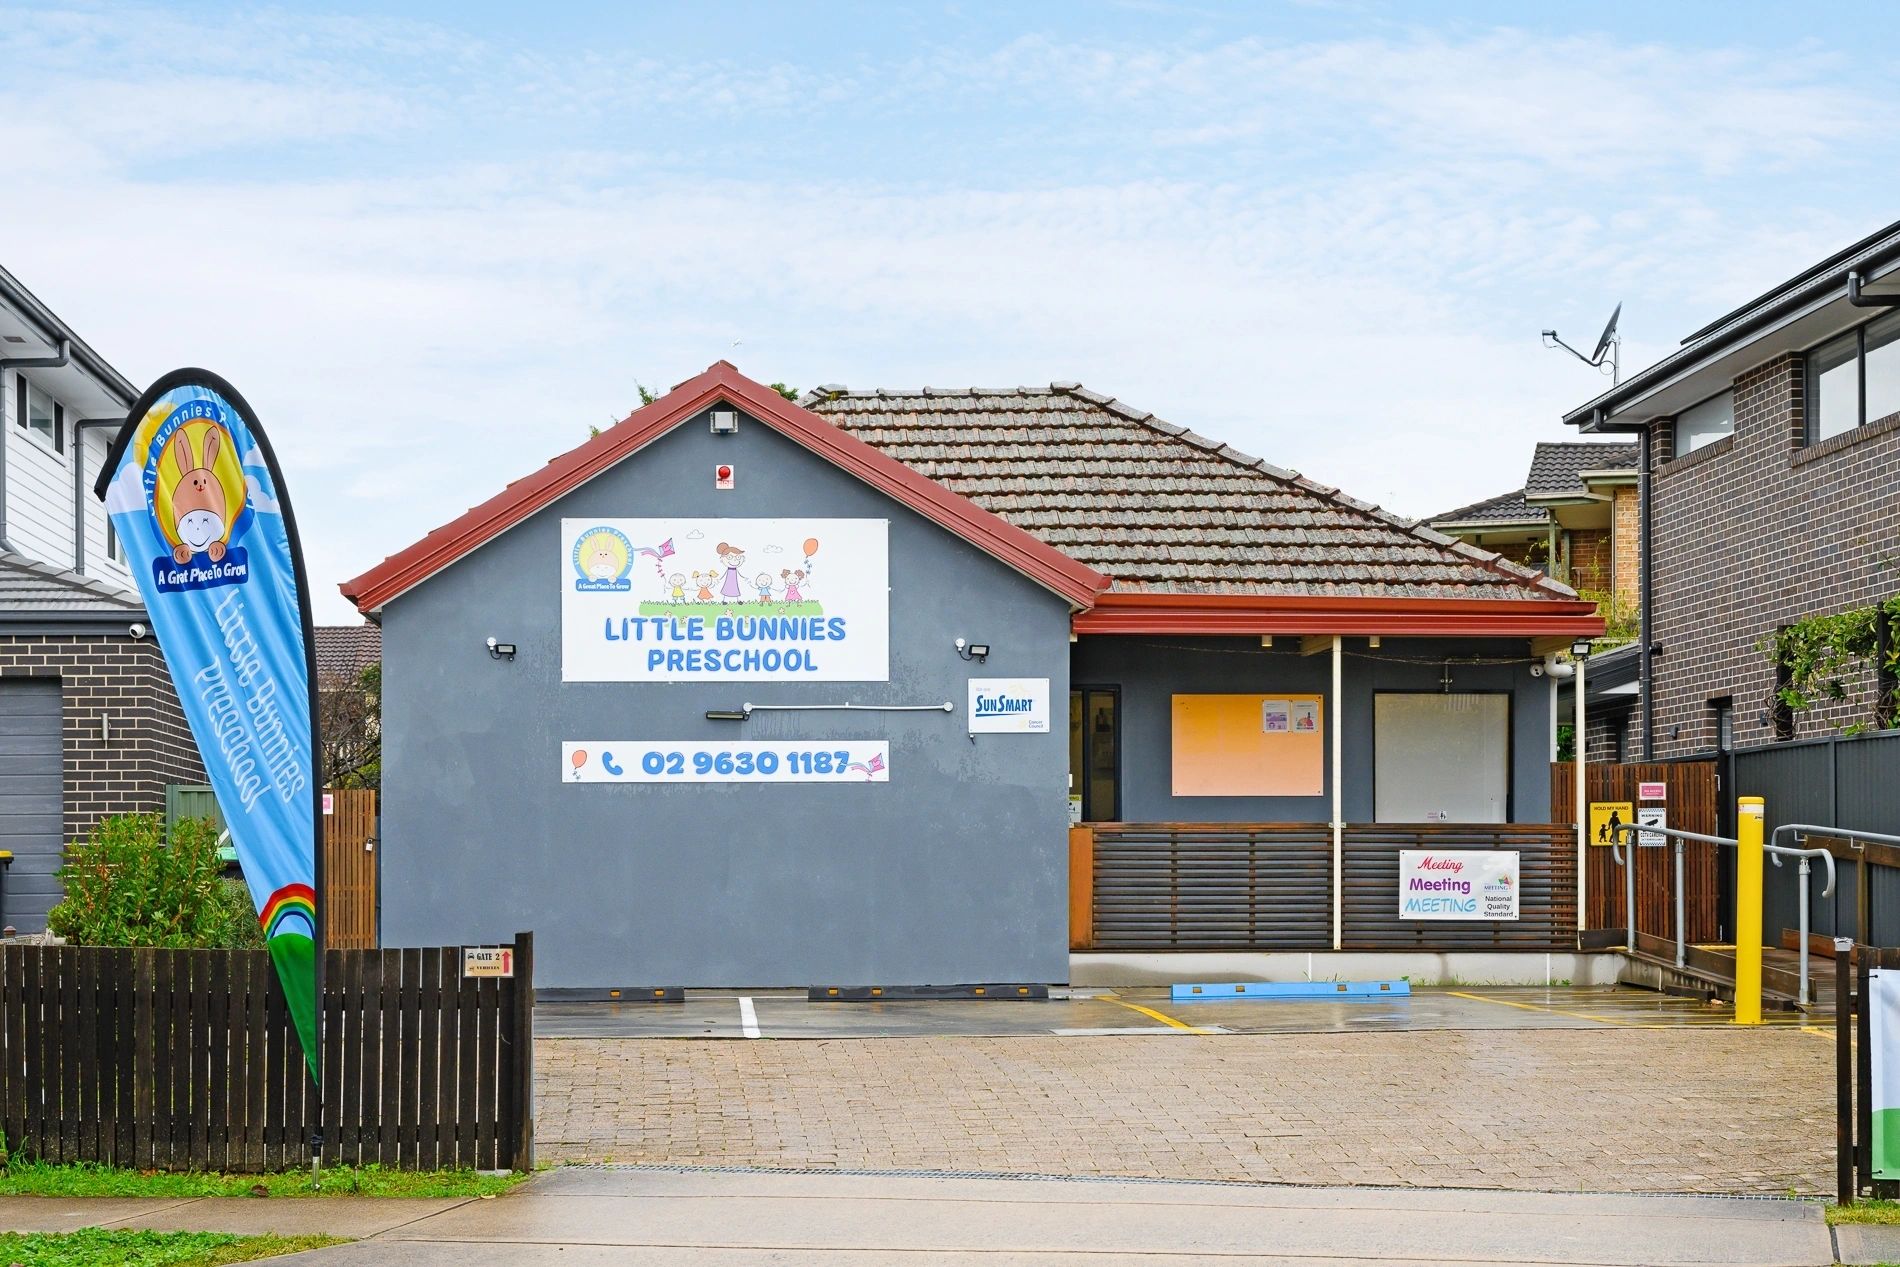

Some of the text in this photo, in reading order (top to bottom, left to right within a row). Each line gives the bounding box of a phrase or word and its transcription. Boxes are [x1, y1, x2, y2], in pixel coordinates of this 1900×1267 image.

[156, 404, 212, 448] Bunnies
[158, 570, 166, 585] A
[168, 570, 188, 585] Grat
[212, 564, 222, 579] To
[605, 617, 846, 641] LITTLE BUNNIES
[647, 648, 818, 672] PRESCHOOL
[215, 587, 305, 804] Little Bunnies
[193, 654, 271, 816] Preschool
[641, 751, 850, 775] 02 9630 1187
[1417, 855, 1464, 873] Meeting
[1409, 877, 1471, 895] Meeting
[1404, 897, 1477, 913] MEETING
[1487, 903, 1511, 911] Quality
[476, 953, 501, 961] GATE 2
